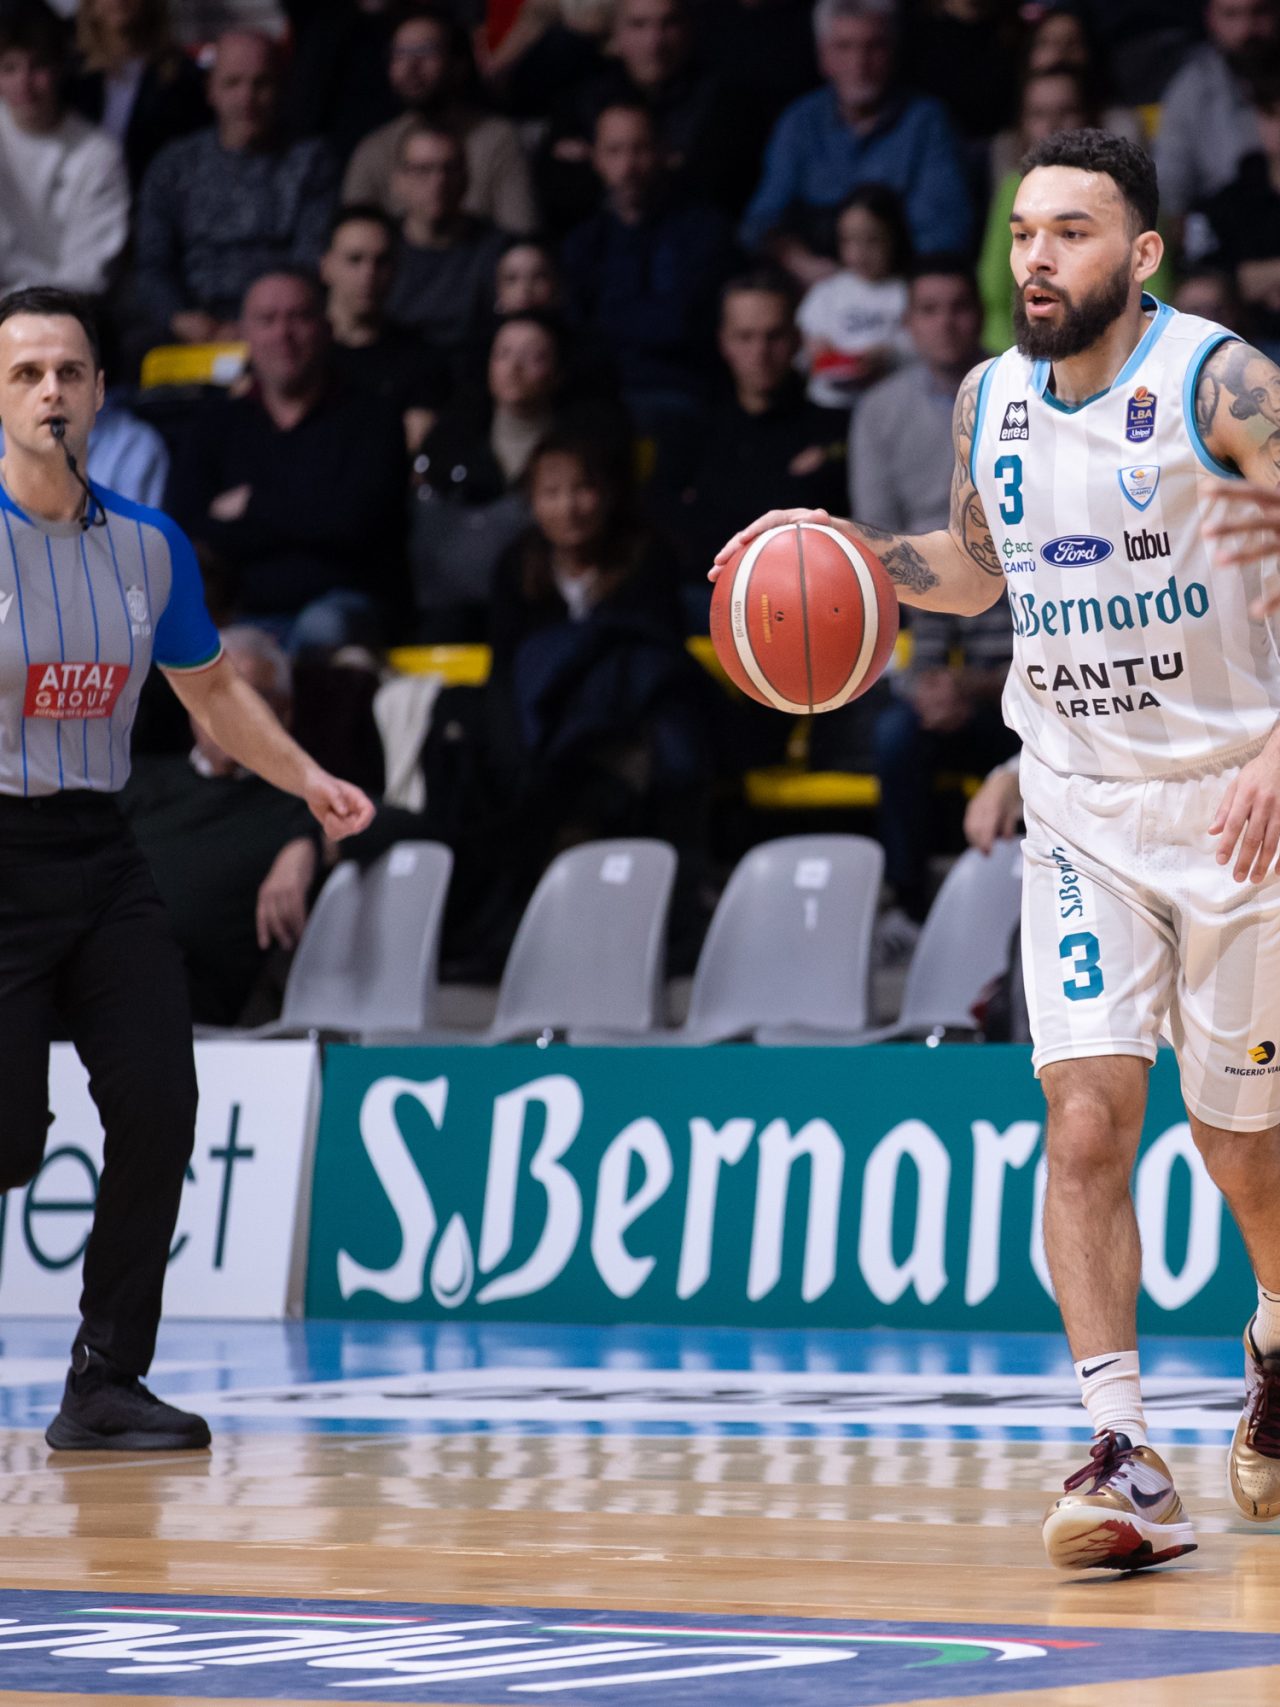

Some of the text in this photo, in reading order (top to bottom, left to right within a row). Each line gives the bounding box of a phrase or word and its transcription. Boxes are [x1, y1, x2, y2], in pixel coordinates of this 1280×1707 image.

[1131, 409, 1153, 420] LBA
[994, 455, 1024, 525] 3
[1015, 542, 1034, 553] BCC
[1054, 540, 1098, 562] Ford
[1123, 529, 1171, 562] tabu
[1004, 558, 1036, 574] CANTÙ
[39, 664, 114, 690] ATTAL
[36, 690, 110, 708] GROUP
[1056, 692, 1162, 718] ARENA
[1059, 931, 1104, 1001] 3
[1224, 1065, 1266, 1077] FRIGERIO
[337, 1074, 1222, 1311] S.Bernaro
[0, 1618, 859, 1692] Unipo
